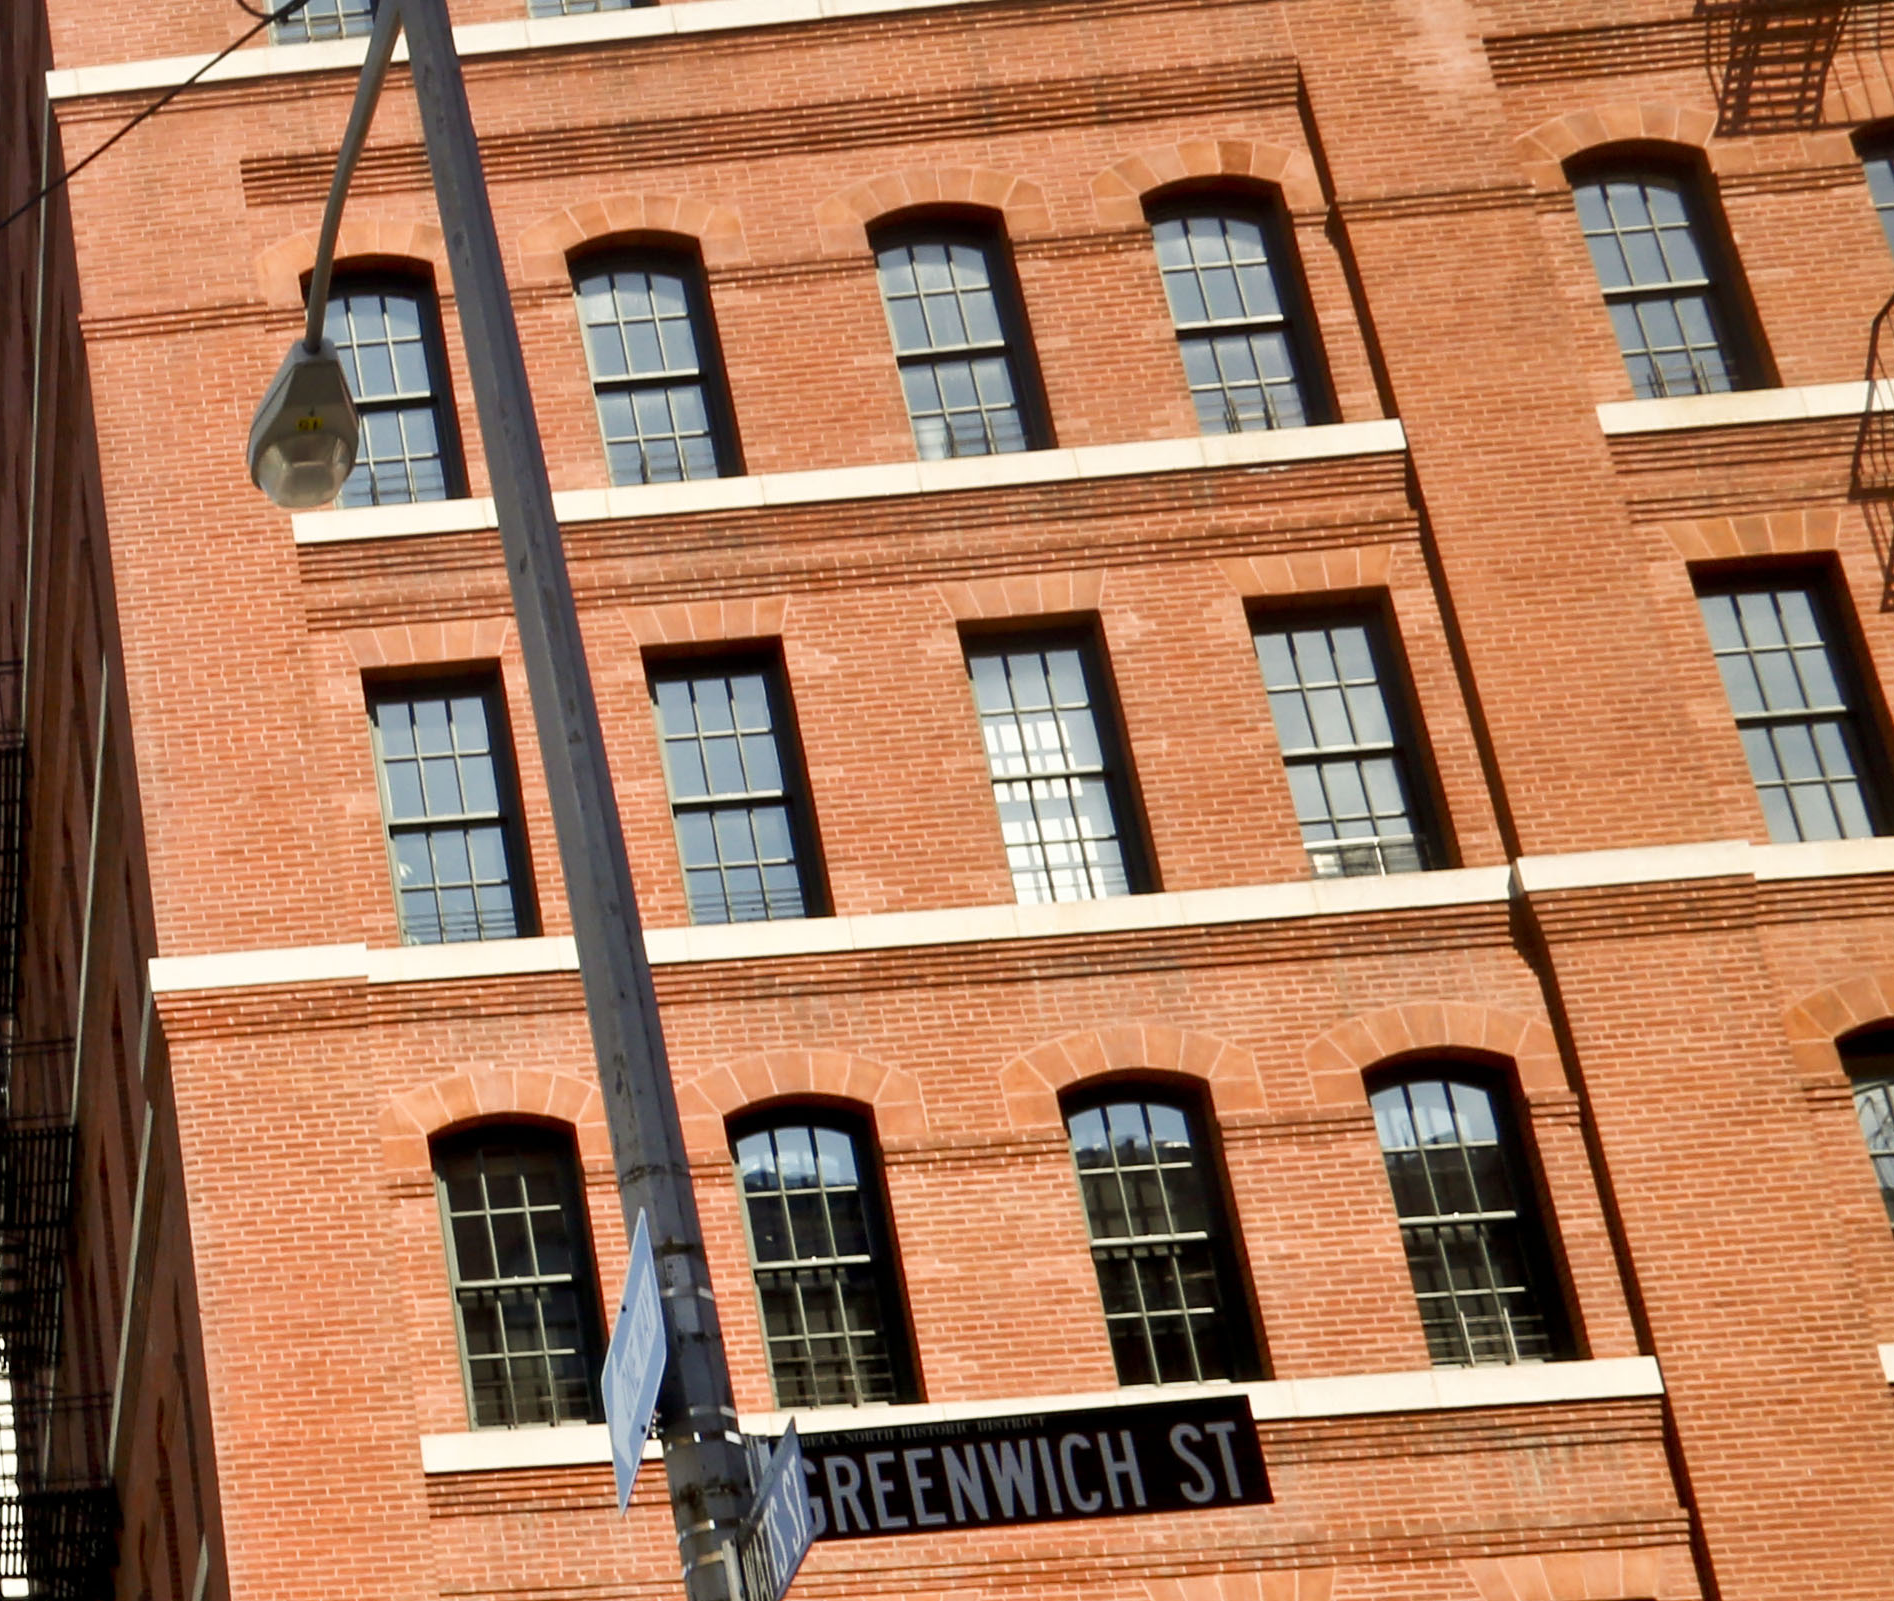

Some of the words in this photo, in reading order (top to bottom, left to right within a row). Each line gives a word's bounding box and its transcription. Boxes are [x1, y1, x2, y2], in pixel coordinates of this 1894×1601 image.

[844, 1428, 894, 1444] NORTH
[901, 1420, 969, 1441] HISTORIC
[977, 1414, 1046, 1432] DISTRICT
[1170, 1420, 1242, 1504] ST
[782, 1454, 808, 1558] ST
